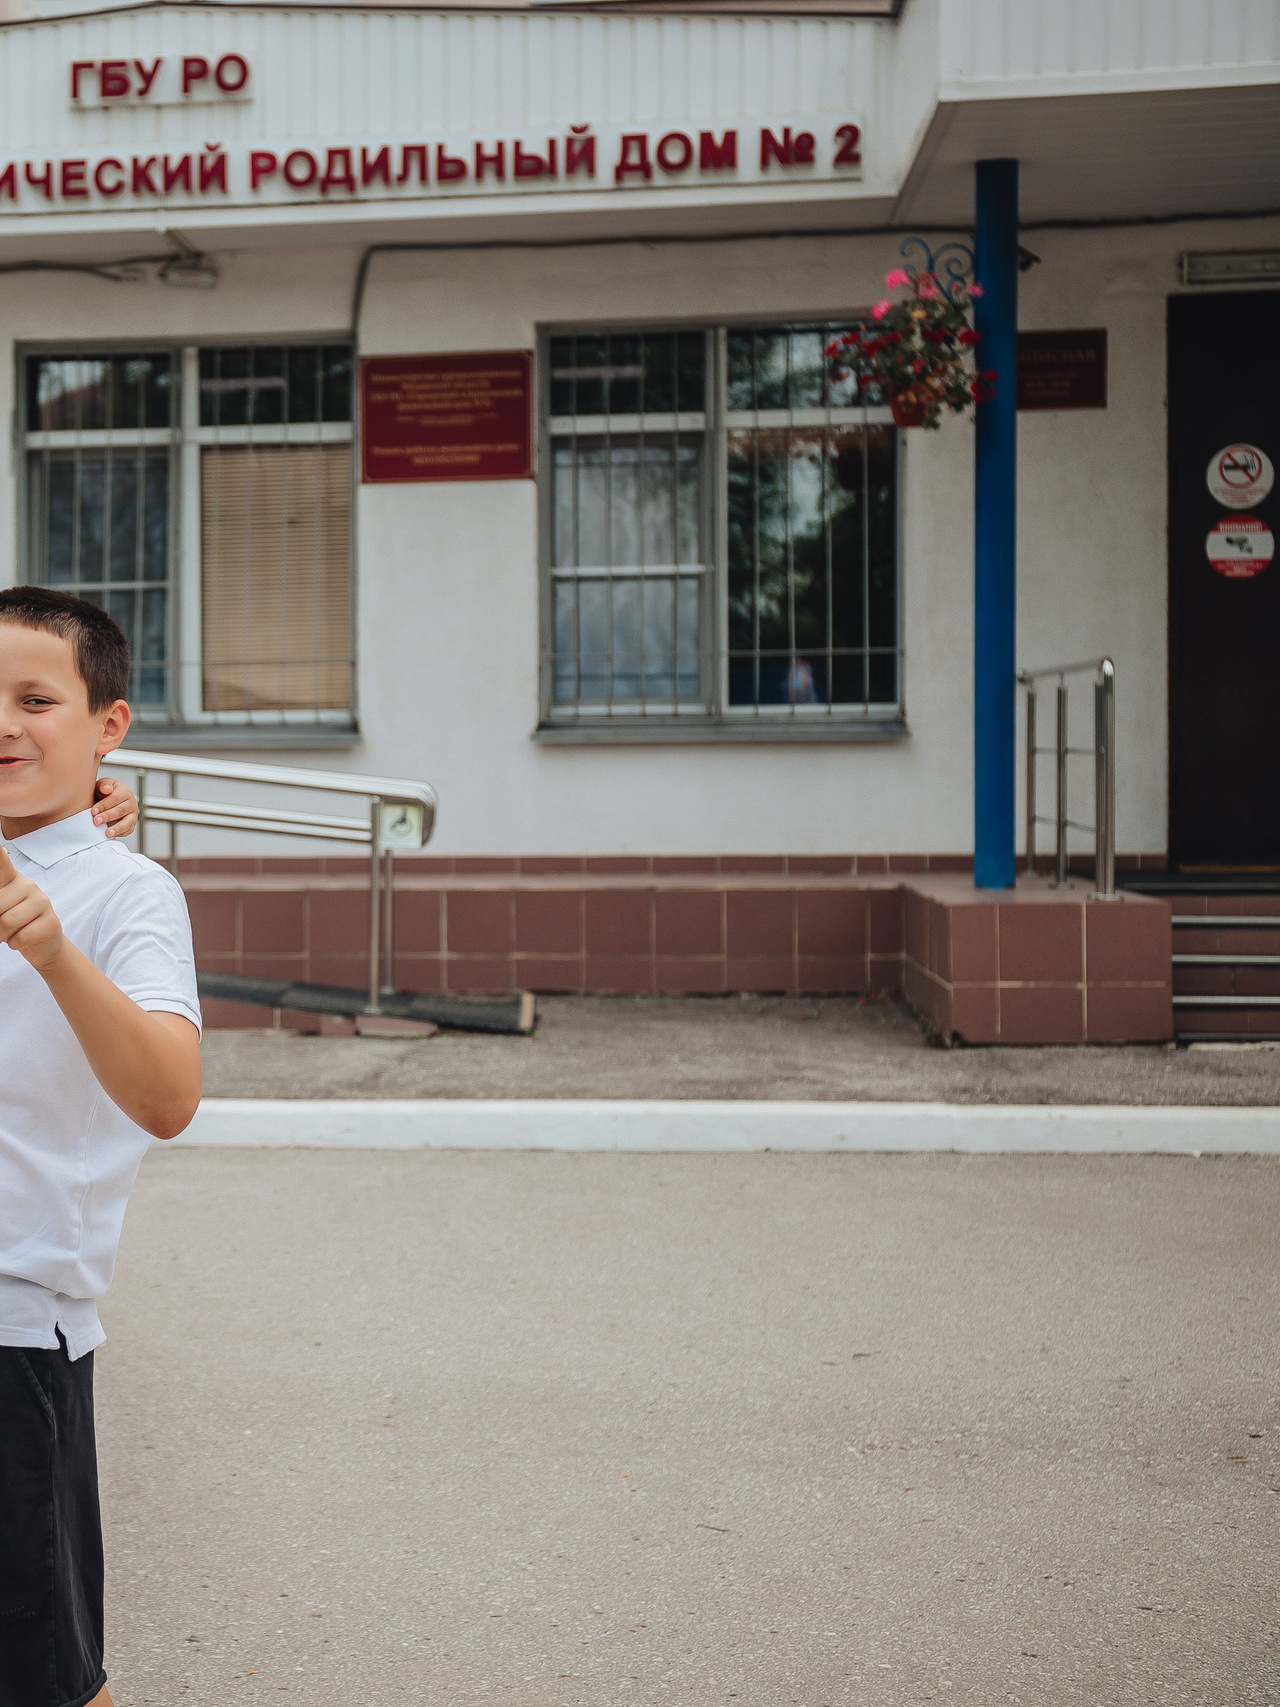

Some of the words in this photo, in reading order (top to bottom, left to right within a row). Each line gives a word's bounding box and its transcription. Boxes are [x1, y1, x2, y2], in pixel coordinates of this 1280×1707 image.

[70, 58, 162, 98] ГБУ
[182, 53, 248, 93] РО
[250, 124, 596, 194] РОДИЛЬНЫЙ
[616, 130, 737, 183] ДОМ
[760, 127, 816, 168] №
[833, 123, 863, 167] 2
